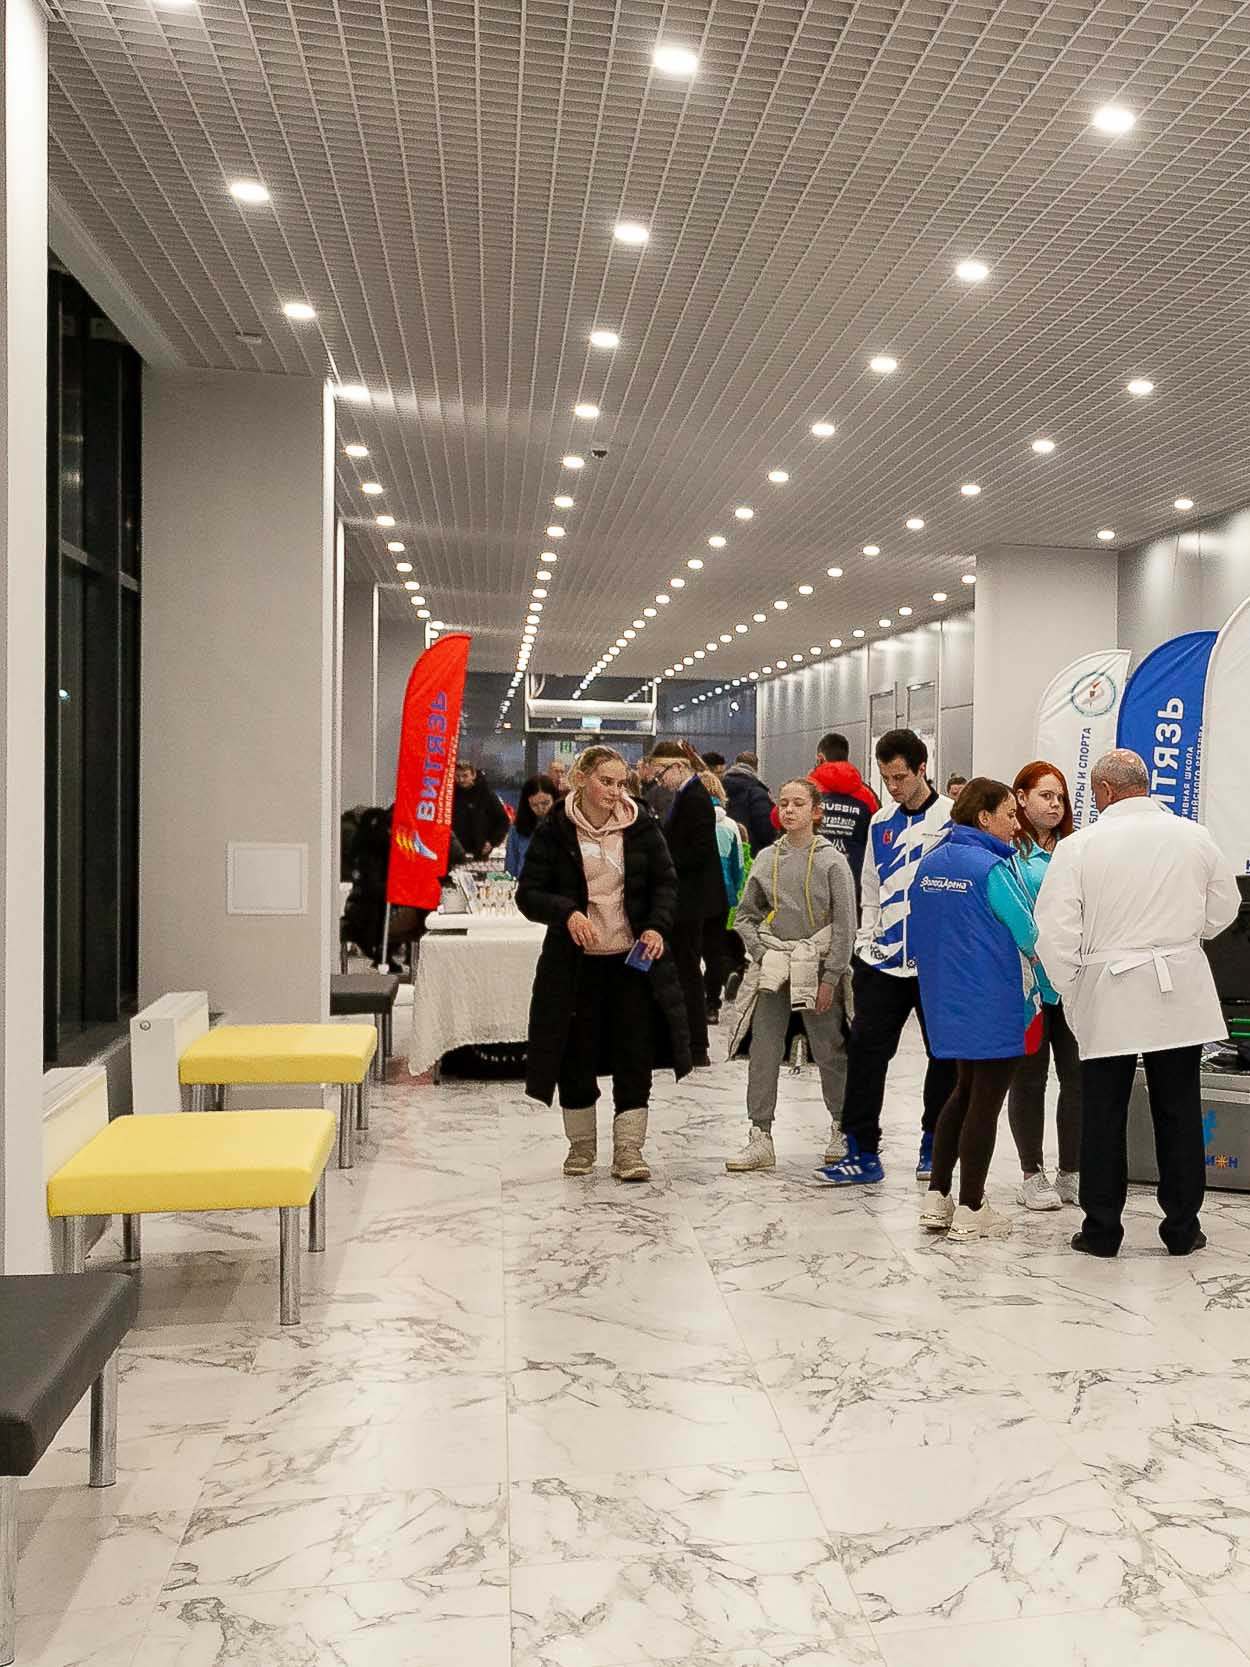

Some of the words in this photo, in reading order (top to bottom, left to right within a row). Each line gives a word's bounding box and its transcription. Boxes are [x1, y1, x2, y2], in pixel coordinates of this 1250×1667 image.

[416, 691, 447, 822] ВИТЯЗЬ
[1079, 728, 1091, 769] СПОРТА
[1151, 697, 1184, 815] ИТЯЗЬ
[1184, 746, 1194, 780] ШКОЛА
[1073, 782, 1086, 831] УЛЬТУРЫ
